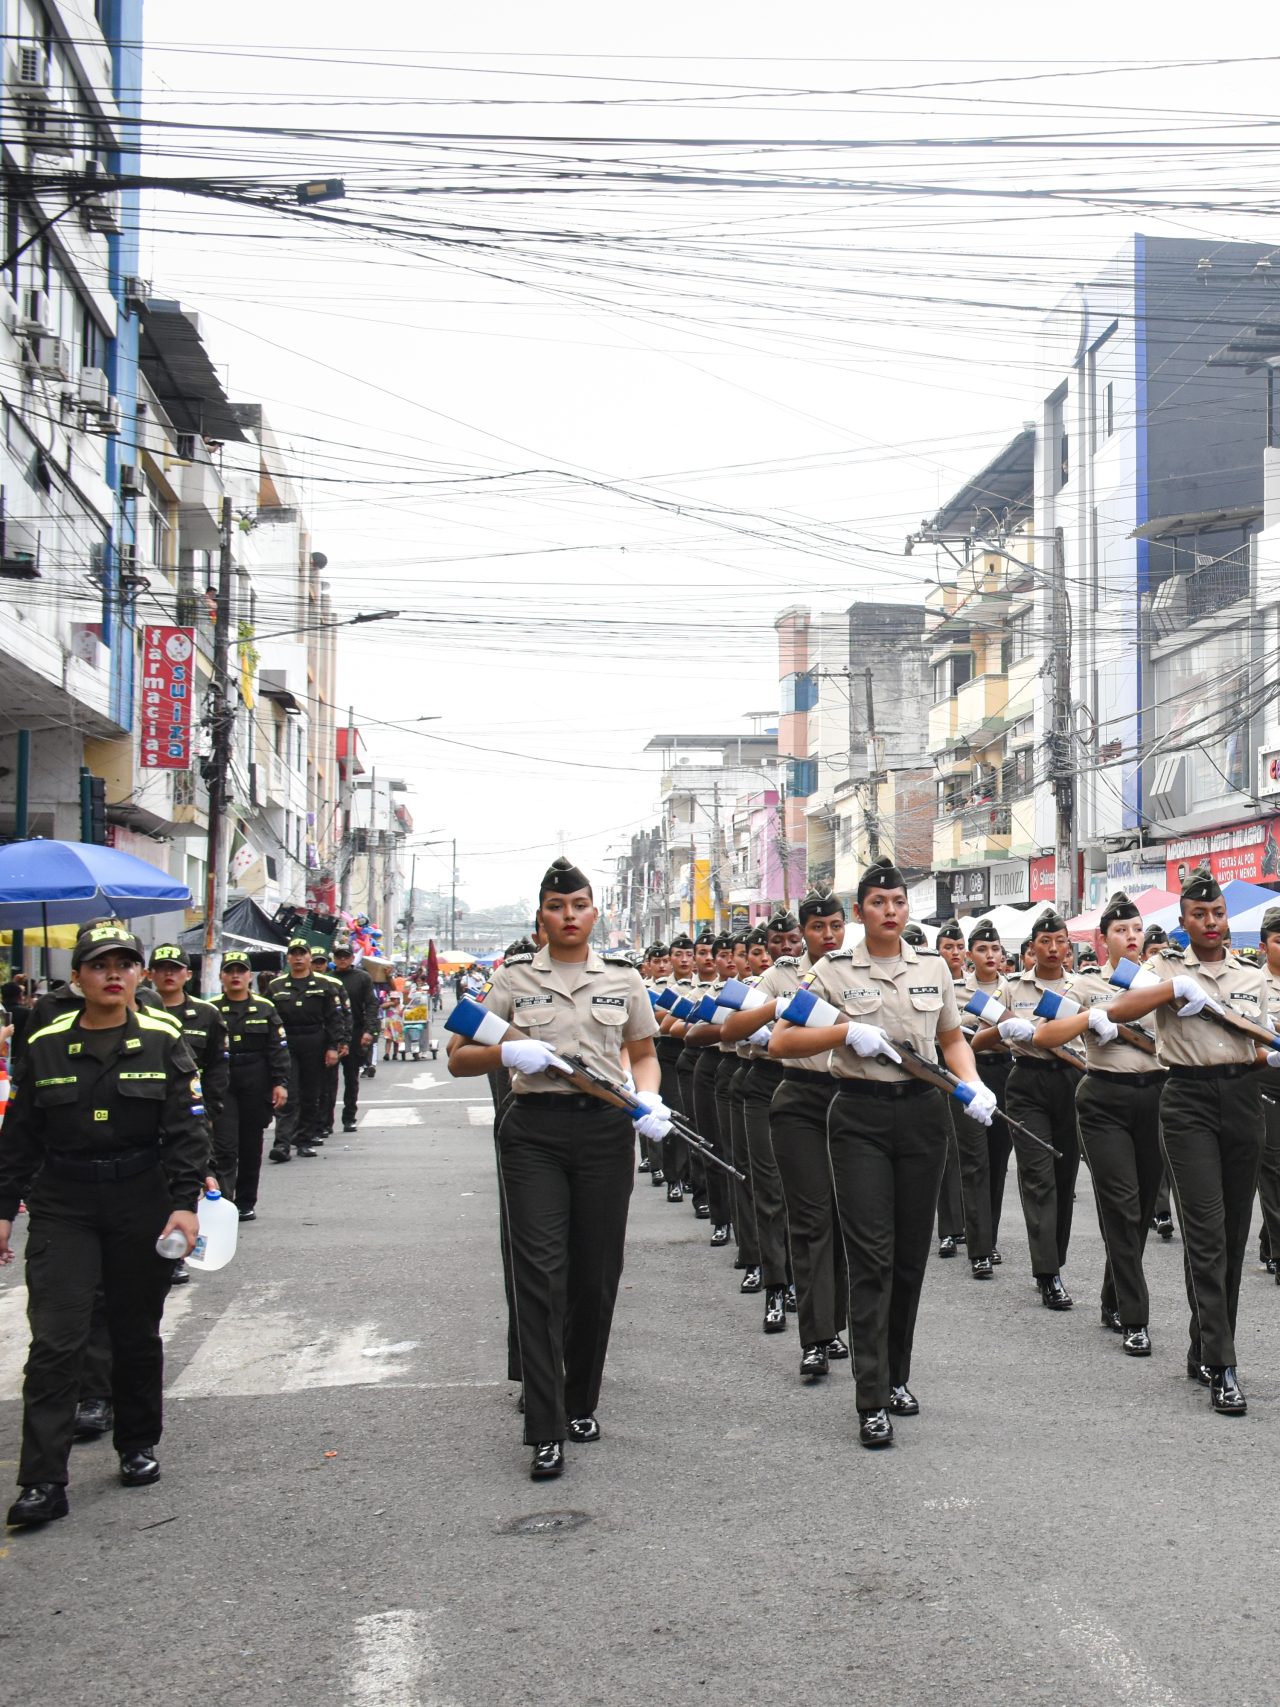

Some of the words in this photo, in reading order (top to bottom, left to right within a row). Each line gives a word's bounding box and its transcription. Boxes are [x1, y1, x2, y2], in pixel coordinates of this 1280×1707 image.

[144, 629, 164, 766] farmacias
[168, 665, 186, 758] suiza
[1218, 856, 1237, 869] VENTAS
[1237, 854, 1244, 866] AL
[1244, 853, 1255, 865] POR
[1217, 869, 1235, 881] MAYOR
[1235, 868, 1239, 879] Y
[1239, 866, 1257, 879] MENOR
[994, 870, 1025, 896] EUROZZ
[155, 945, 181, 960] EFP
[225, 951, 248, 961] EFP
